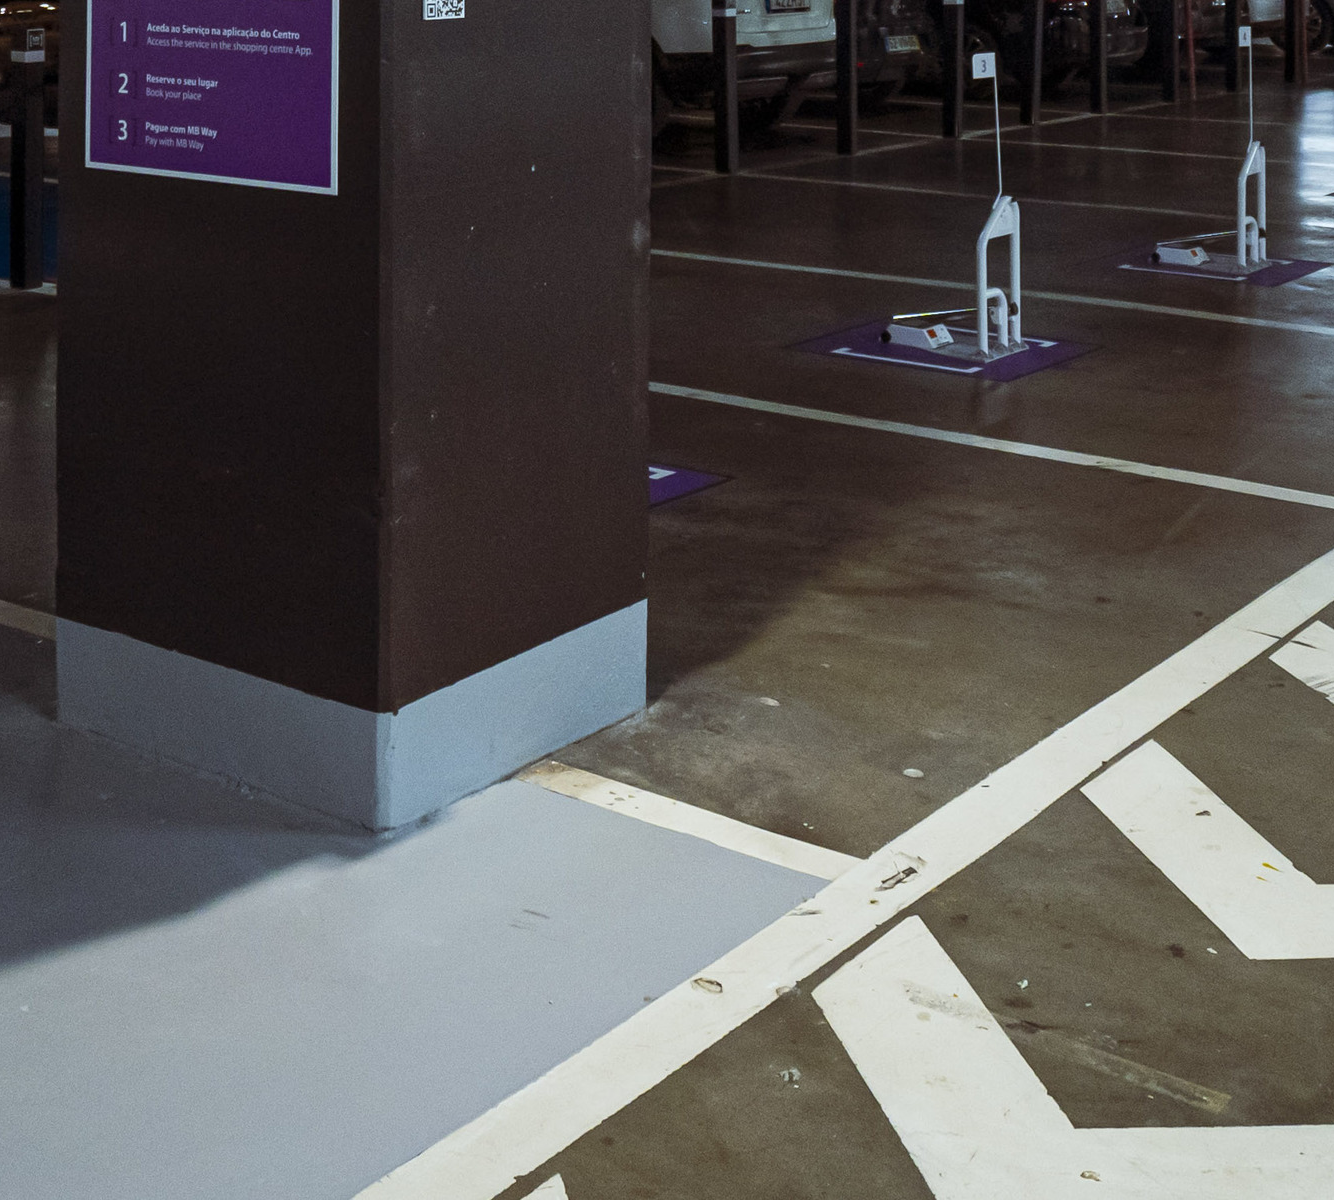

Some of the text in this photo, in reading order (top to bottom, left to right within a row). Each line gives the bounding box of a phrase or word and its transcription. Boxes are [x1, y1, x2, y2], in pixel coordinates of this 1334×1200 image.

[119, 21, 128, 42] 1
[147, 22, 170, 33] Aceda
[170, 25, 180, 34] ao
[182, 25, 210, 36] Serviço
[211, 27, 221, 36] na
[261, 28, 271, 38] do
[272, 29, 300, 40] Centro
[147, 36, 170, 47] Access
[981, 60, 987, 73] 3
[118, 72, 129, 94] 2
[146, 73, 176, 85] Reserve
[183, 78, 197, 87] seu
[198, 76, 219, 90] lugar
[146, 87, 164, 98] Book
[117, 119, 128, 141] 3
[145, 121, 218, 140] Pague com MB Way
[145, 134, 204, 152] Pay with MB Way
